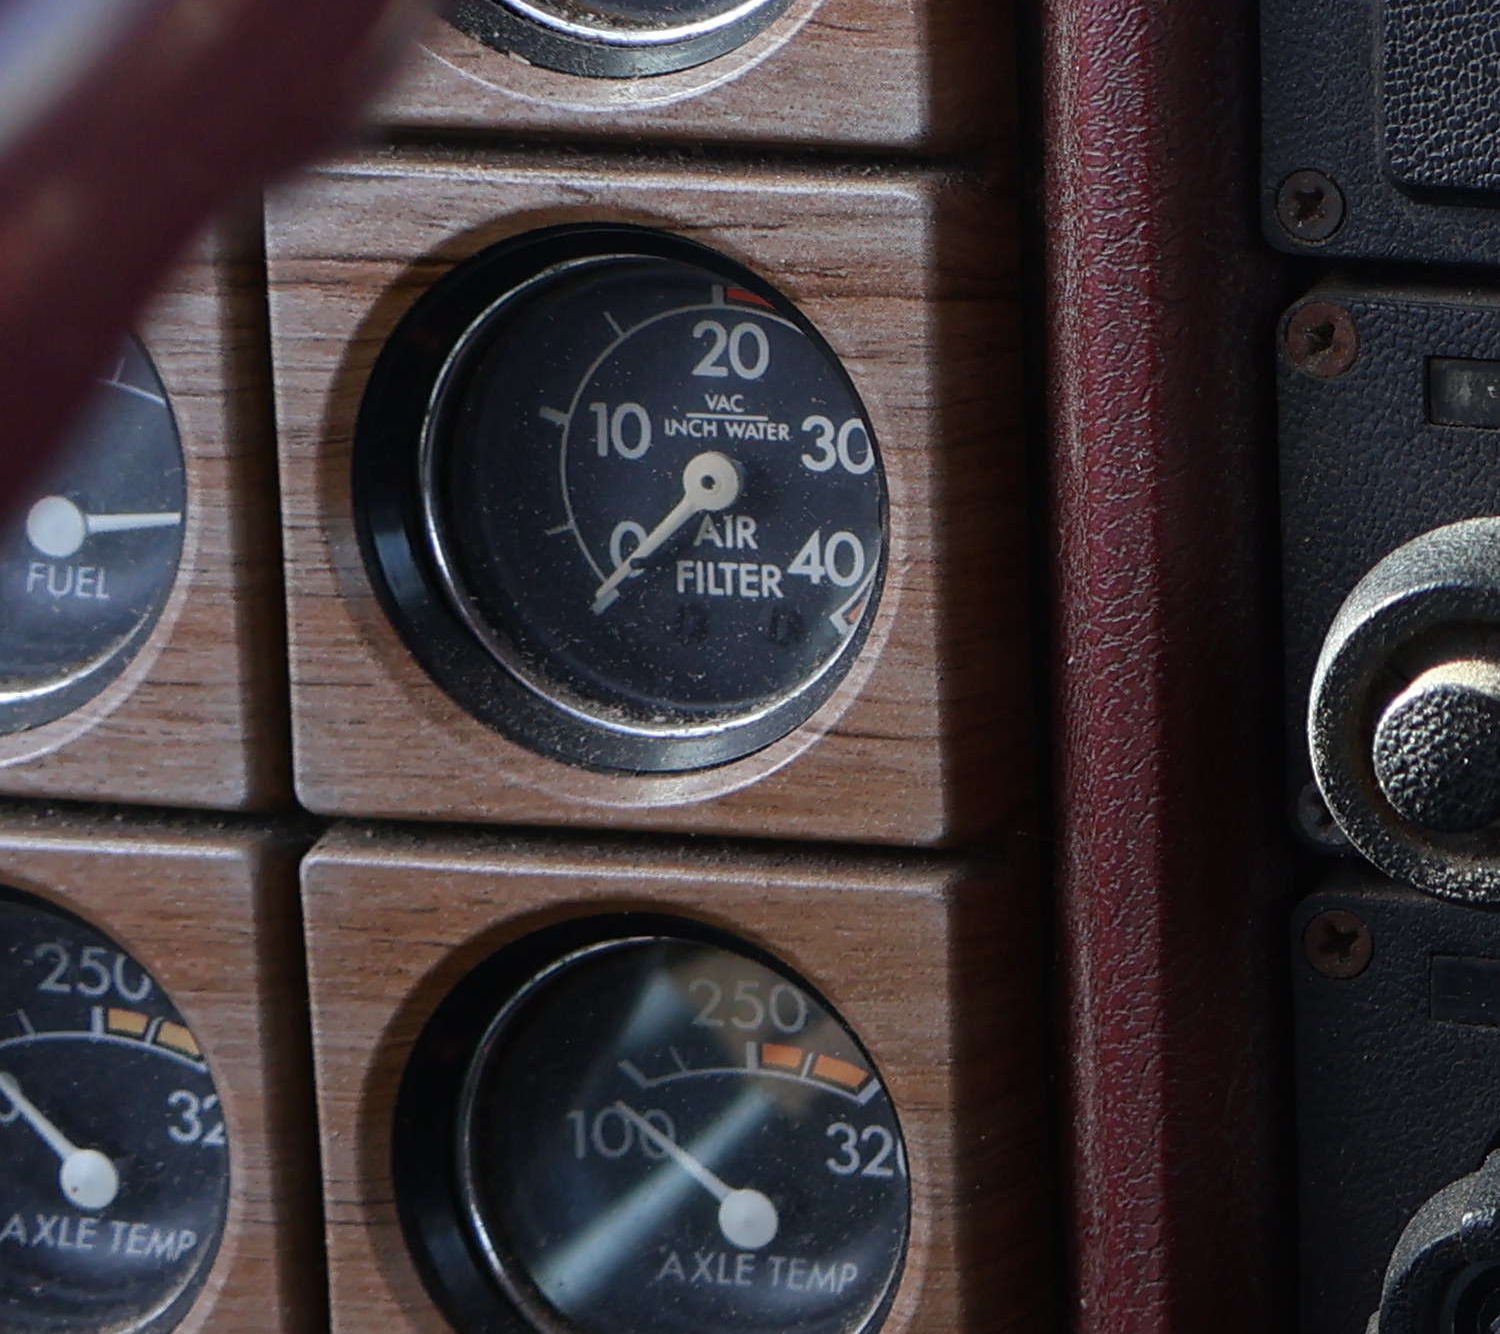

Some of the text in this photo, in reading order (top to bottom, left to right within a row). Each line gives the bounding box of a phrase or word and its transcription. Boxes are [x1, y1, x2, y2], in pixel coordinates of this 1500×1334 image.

[691, 319, 770, 380] 20
[704, 393, 745, 413] VAC
[588, 402, 652, 460] 10
[664, 418, 790, 441] INCH WATER
[801, 415, 876, 475] 30
[693, 514, 758, 550] AIR
[26, 561, 110, 600] FUEL
[676, 559, 784, 598] FILTER
[786, 529, 865, 588] 40
[34, 942, 153, 1002] 250
[688, 979, 809, 1033] 250
[566, 1108, 677, 1160] 100
[825, 1121, 907, 1178] 32
[0, 1213, 198, 1262] AXLE TEMP
[655, 1250, 859, 1294] AXLE TEMP
